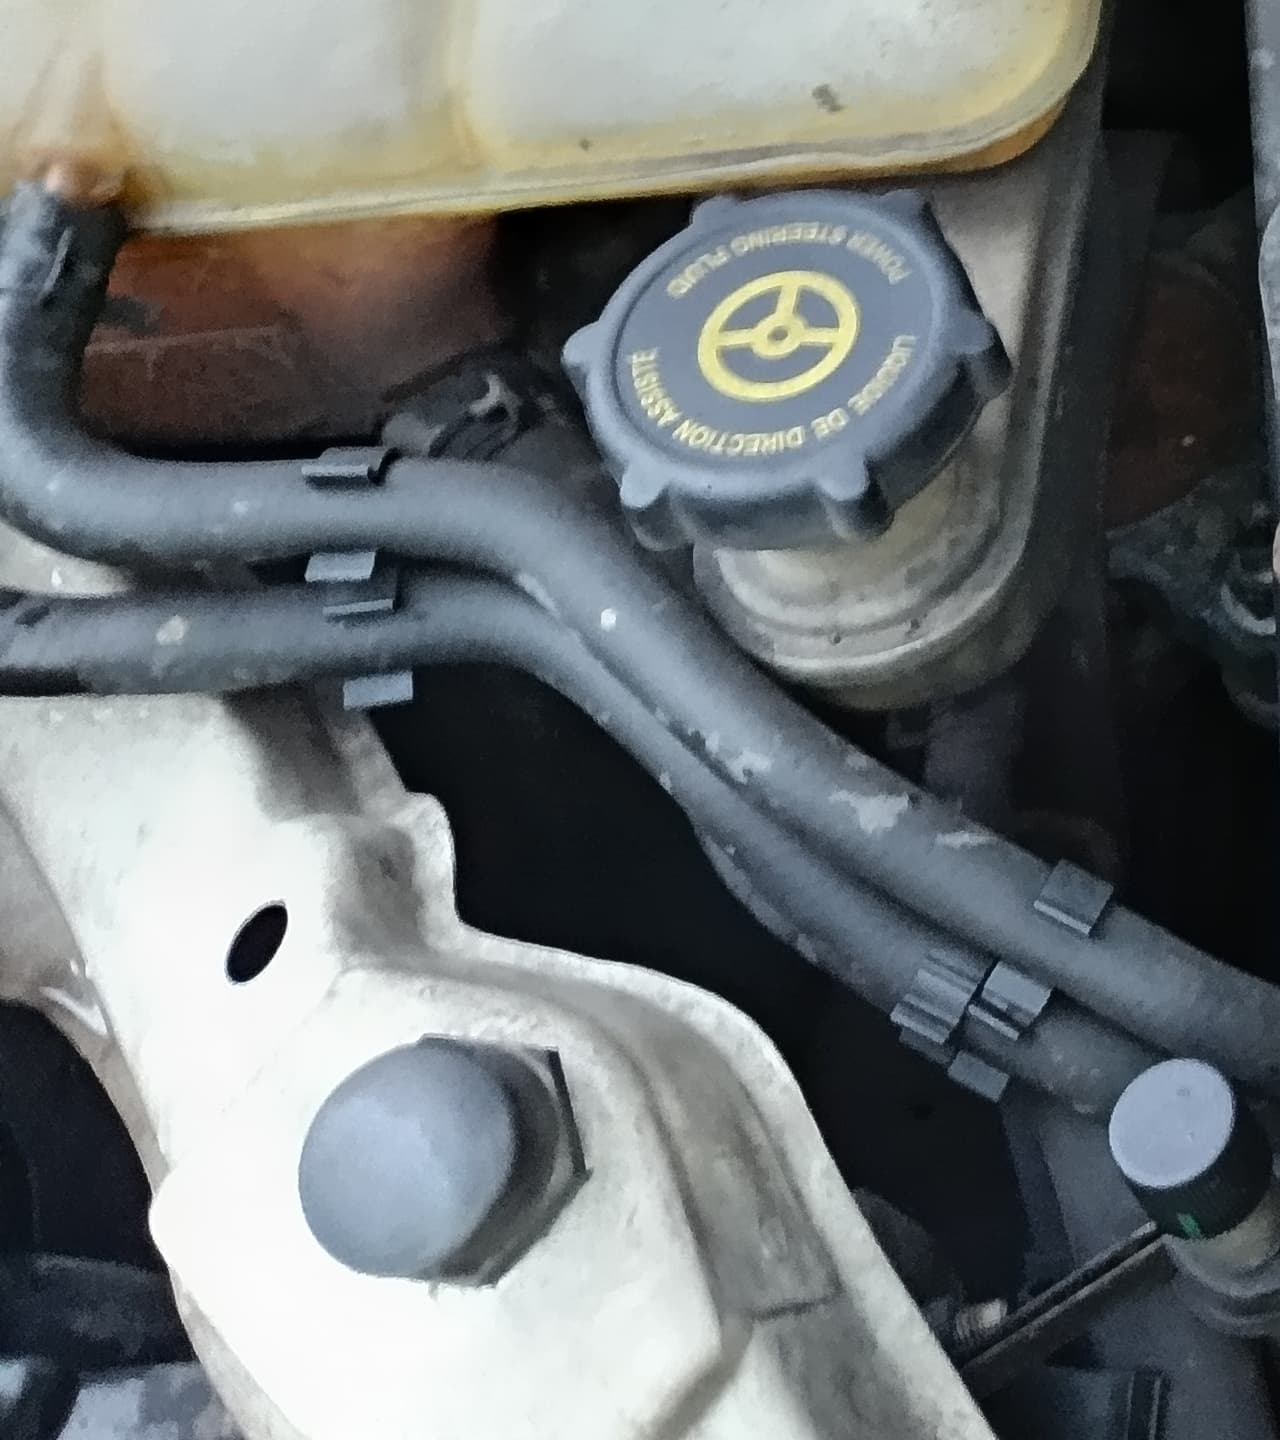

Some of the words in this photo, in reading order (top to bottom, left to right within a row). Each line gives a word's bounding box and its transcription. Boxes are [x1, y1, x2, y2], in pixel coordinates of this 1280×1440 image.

[731, 223, 848, 253] STEERING
[846, 228, 912, 285] POWER
[666, 250, 729, 299] FLUID
[672, 419, 805, 457] DIRECTION
[811, 408, 848, 439] DE
